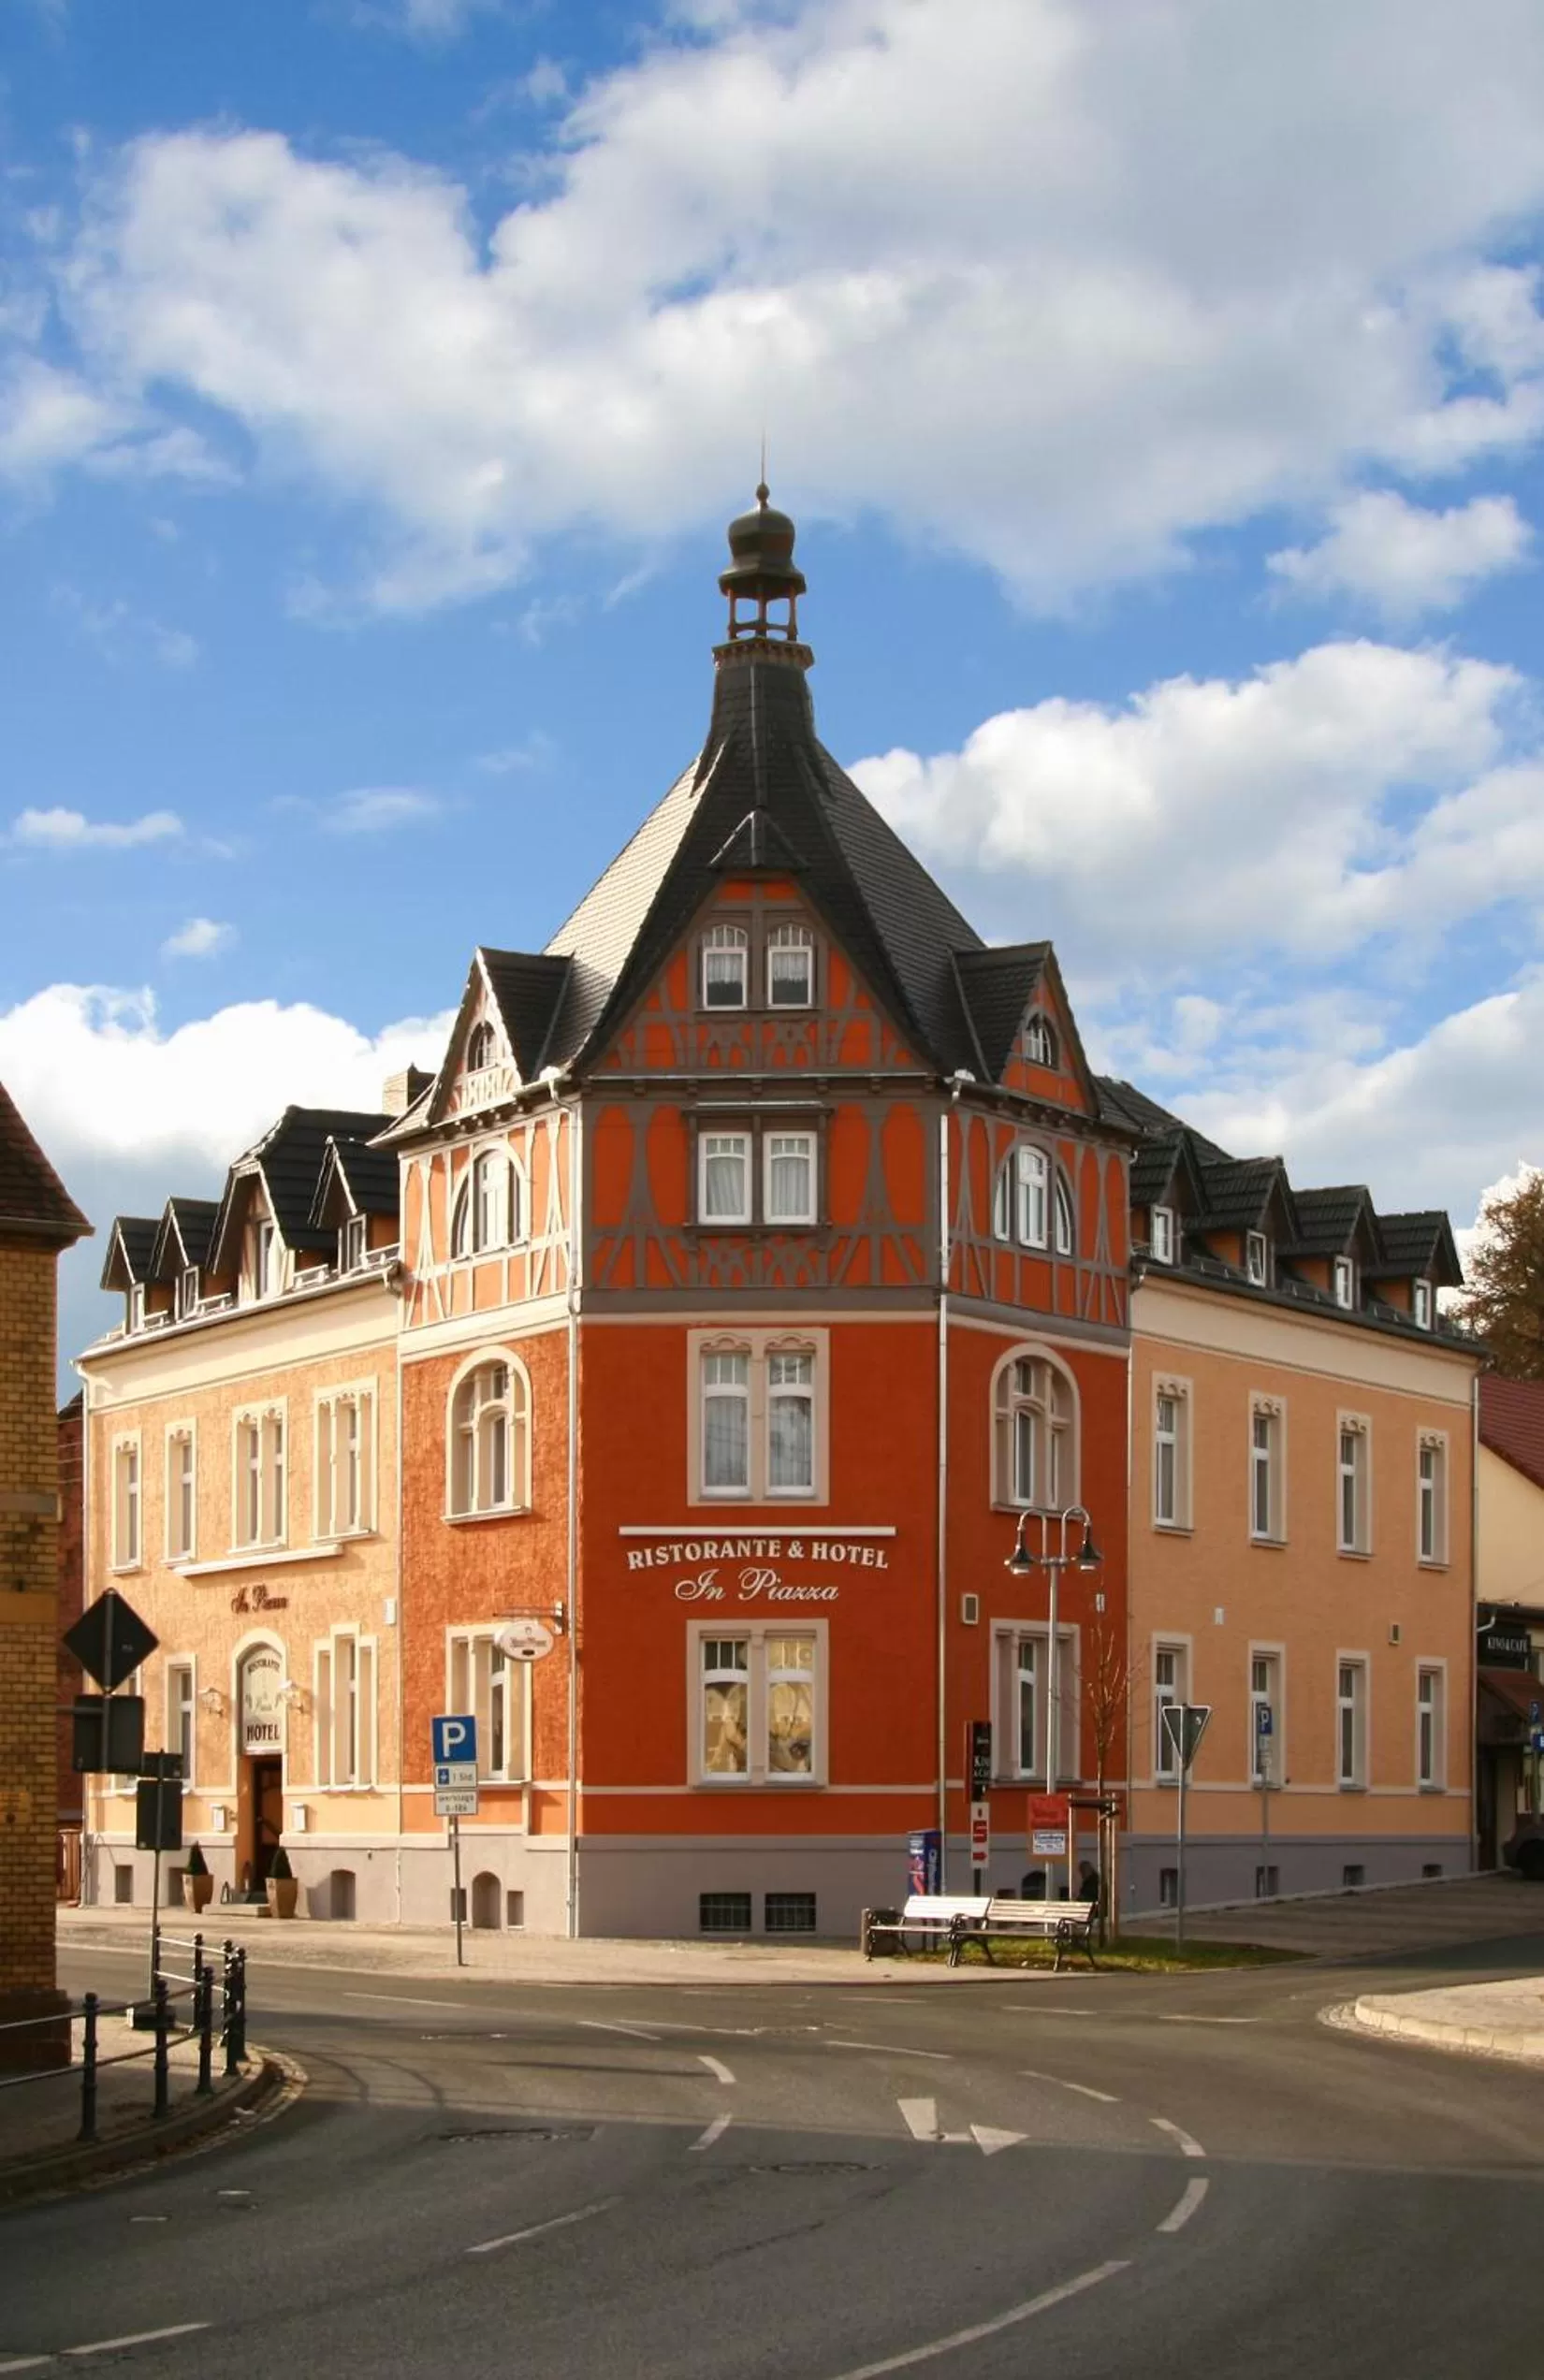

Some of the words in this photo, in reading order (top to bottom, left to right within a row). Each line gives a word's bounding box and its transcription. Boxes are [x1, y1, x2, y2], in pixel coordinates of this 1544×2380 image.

[626, 1539, 781, 1571] RISTORANTE
[787, 1540, 805, 1559] &
[811, 1542, 889, 1569] HOTEL
[674, 1567, 726, 1601] In
[737, 1566, 839, 1601] Piazza
[246, 1723, 281, 1741] HOTEL
[1260, 1709, 1270, 1732] P
[442, 1721, 467, 1759] P
